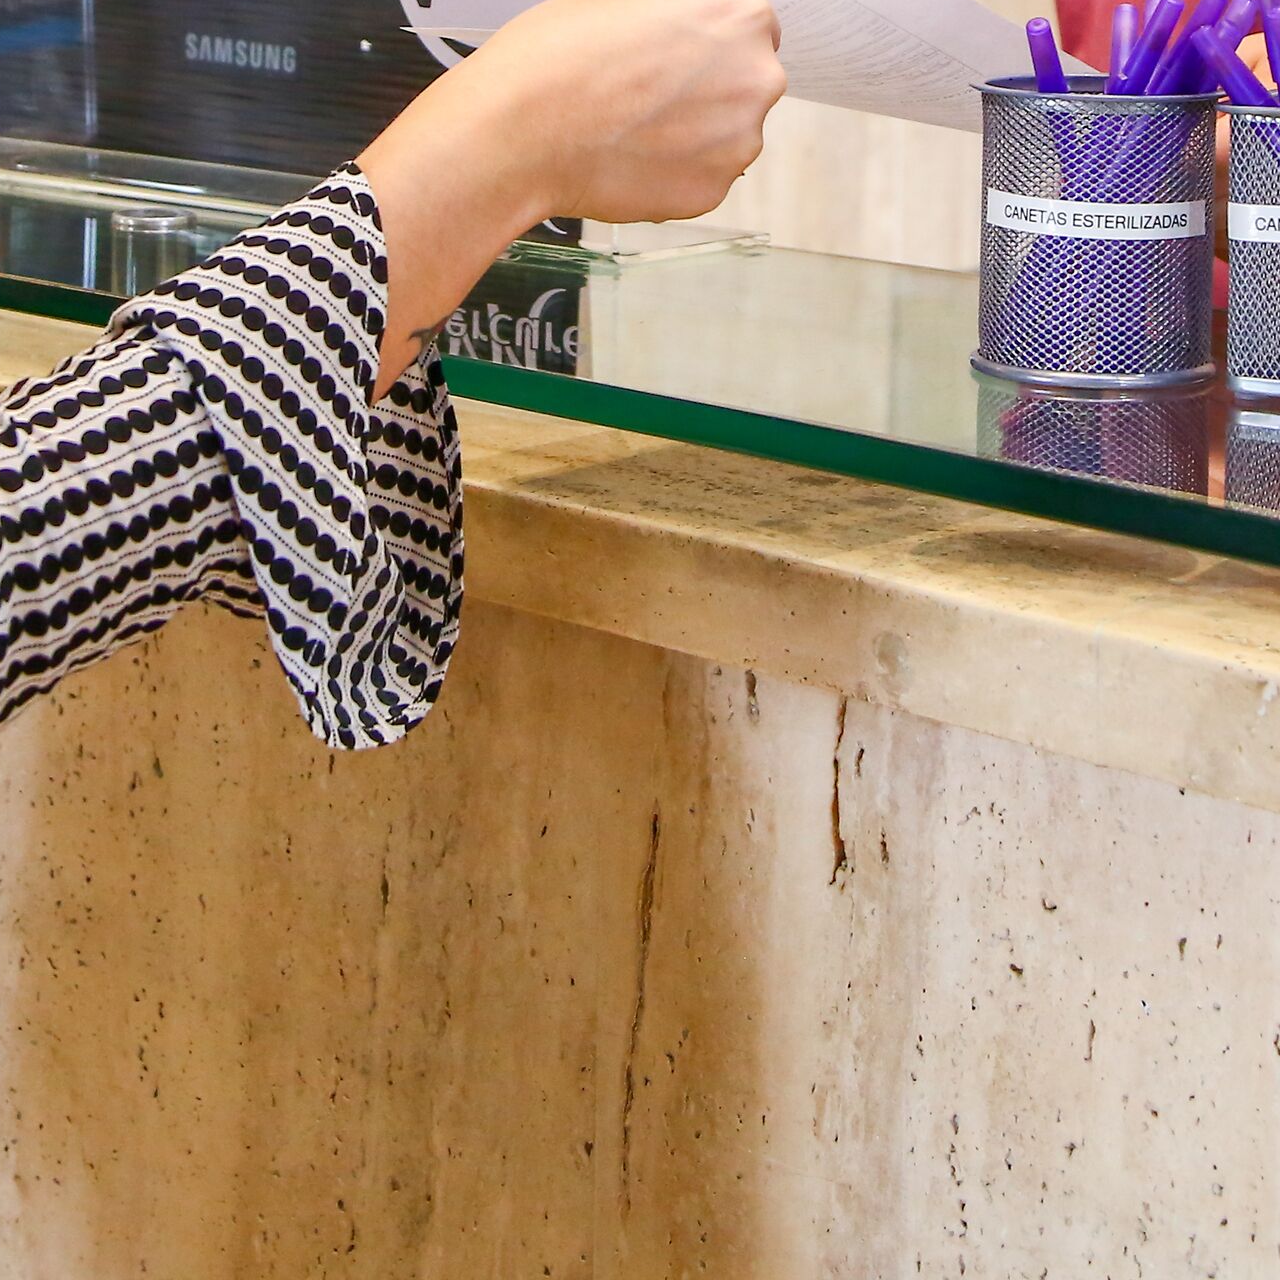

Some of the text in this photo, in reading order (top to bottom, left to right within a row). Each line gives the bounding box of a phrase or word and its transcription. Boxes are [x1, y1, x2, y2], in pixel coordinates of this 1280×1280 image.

[185, 32, 297, 73] SAMSUNG
[1004, 204, 1188, 230] CANETAS ESTERILIZADAS
